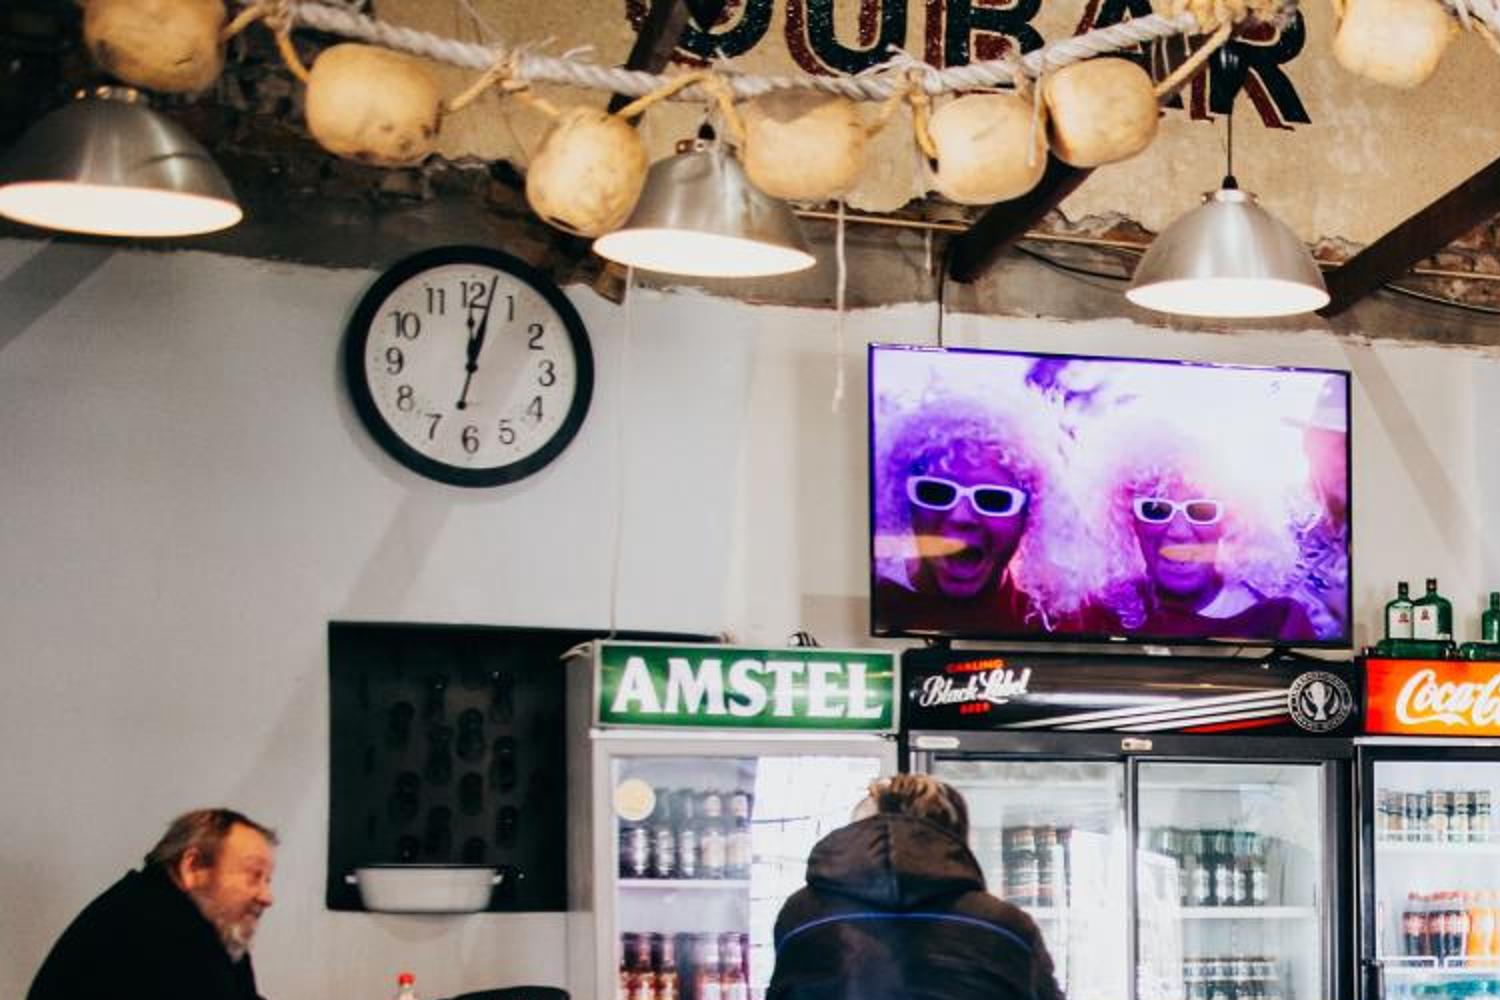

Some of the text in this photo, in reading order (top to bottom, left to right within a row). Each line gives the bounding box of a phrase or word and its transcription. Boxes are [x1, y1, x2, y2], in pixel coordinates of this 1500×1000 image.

[426, 287, 446, 316] 11
[460, 281, 487, 309] 12
[505, 295, 515, 322] 1
[389, 310, 421, 340] 10
[528, 323, 545, 351] 2
[386, 347, 404, 375] 9
[538, 360, 556, 387] 3
[397, 385, 414, 412] 8
[526, 395, 543, 422] 4
[425, 413, 443, 441] 7
[461, 425, 480, 454] 6
[499, 419, 515, 445] 5
[610, 656, 884, 719] AMSTEL
[919, 668, 1032, 707] Black Label
